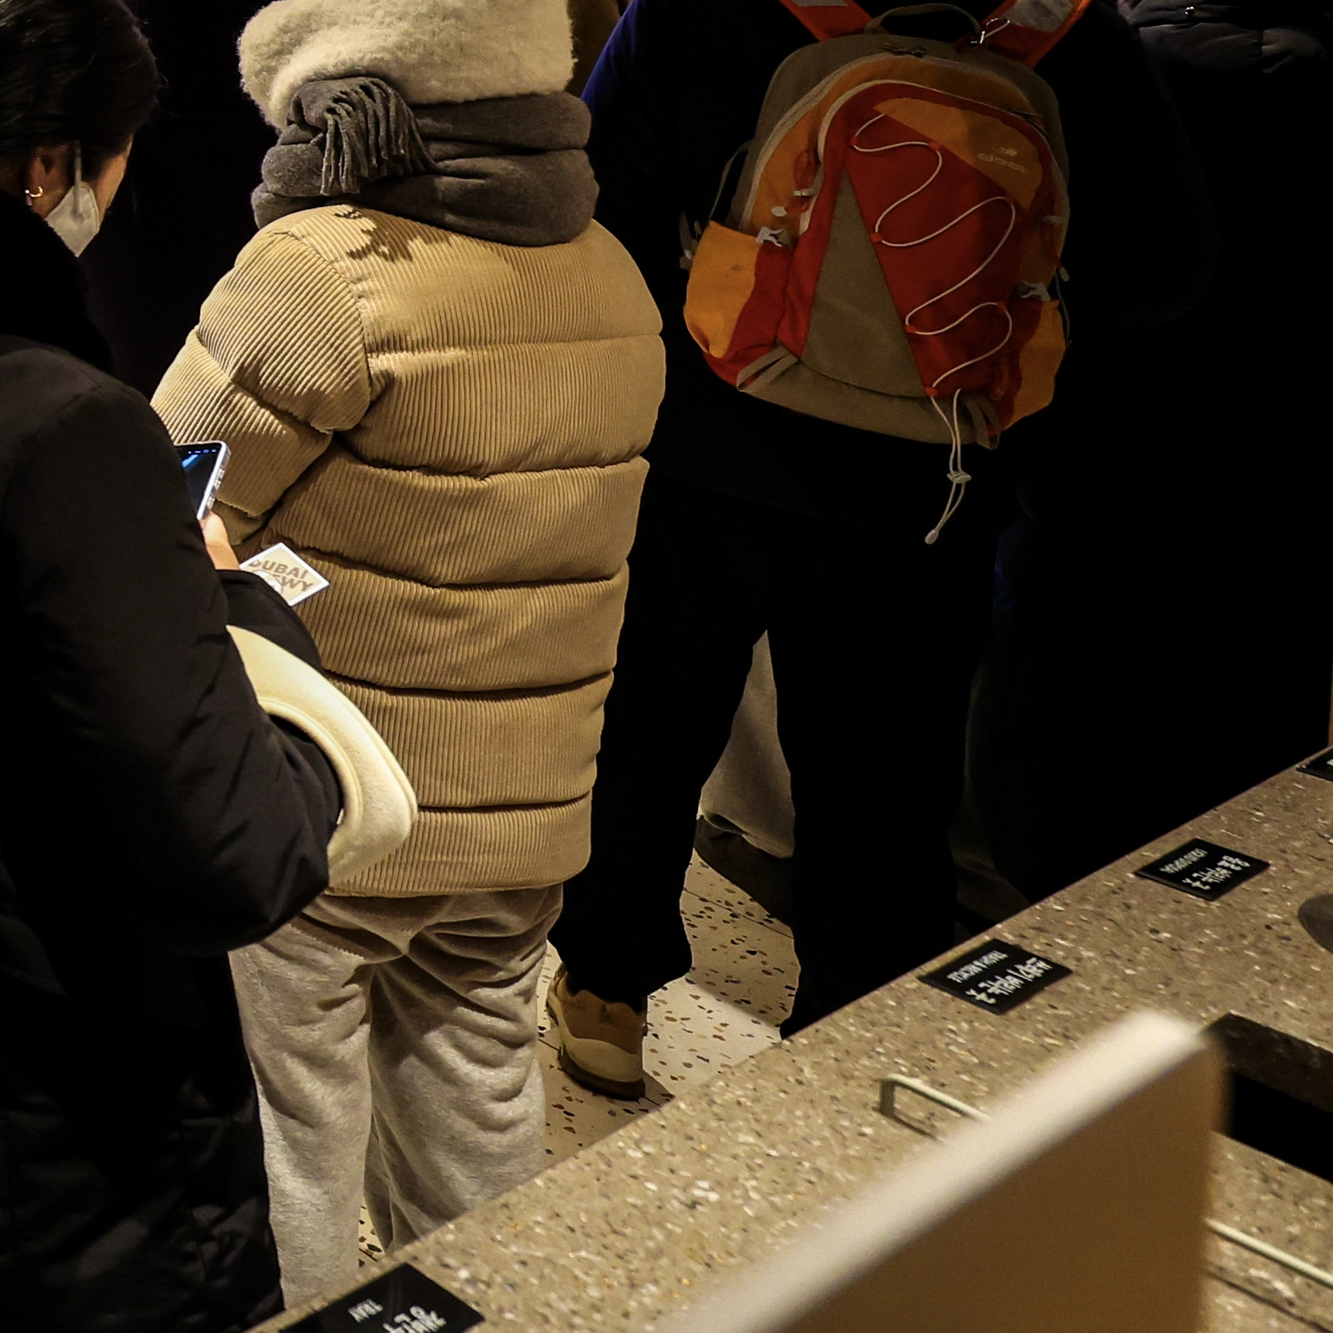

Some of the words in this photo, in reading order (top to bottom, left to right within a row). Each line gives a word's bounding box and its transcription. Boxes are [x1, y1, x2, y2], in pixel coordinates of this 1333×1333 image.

[248, 559, 309, 580] DUBAI
[1181, 877, 1212, 891] 곳
[1006, 956, 1053, 983] 쓰레기
[977, 974, 1025, 996] 버리는
[965, 988, 997, 1005] 곳
